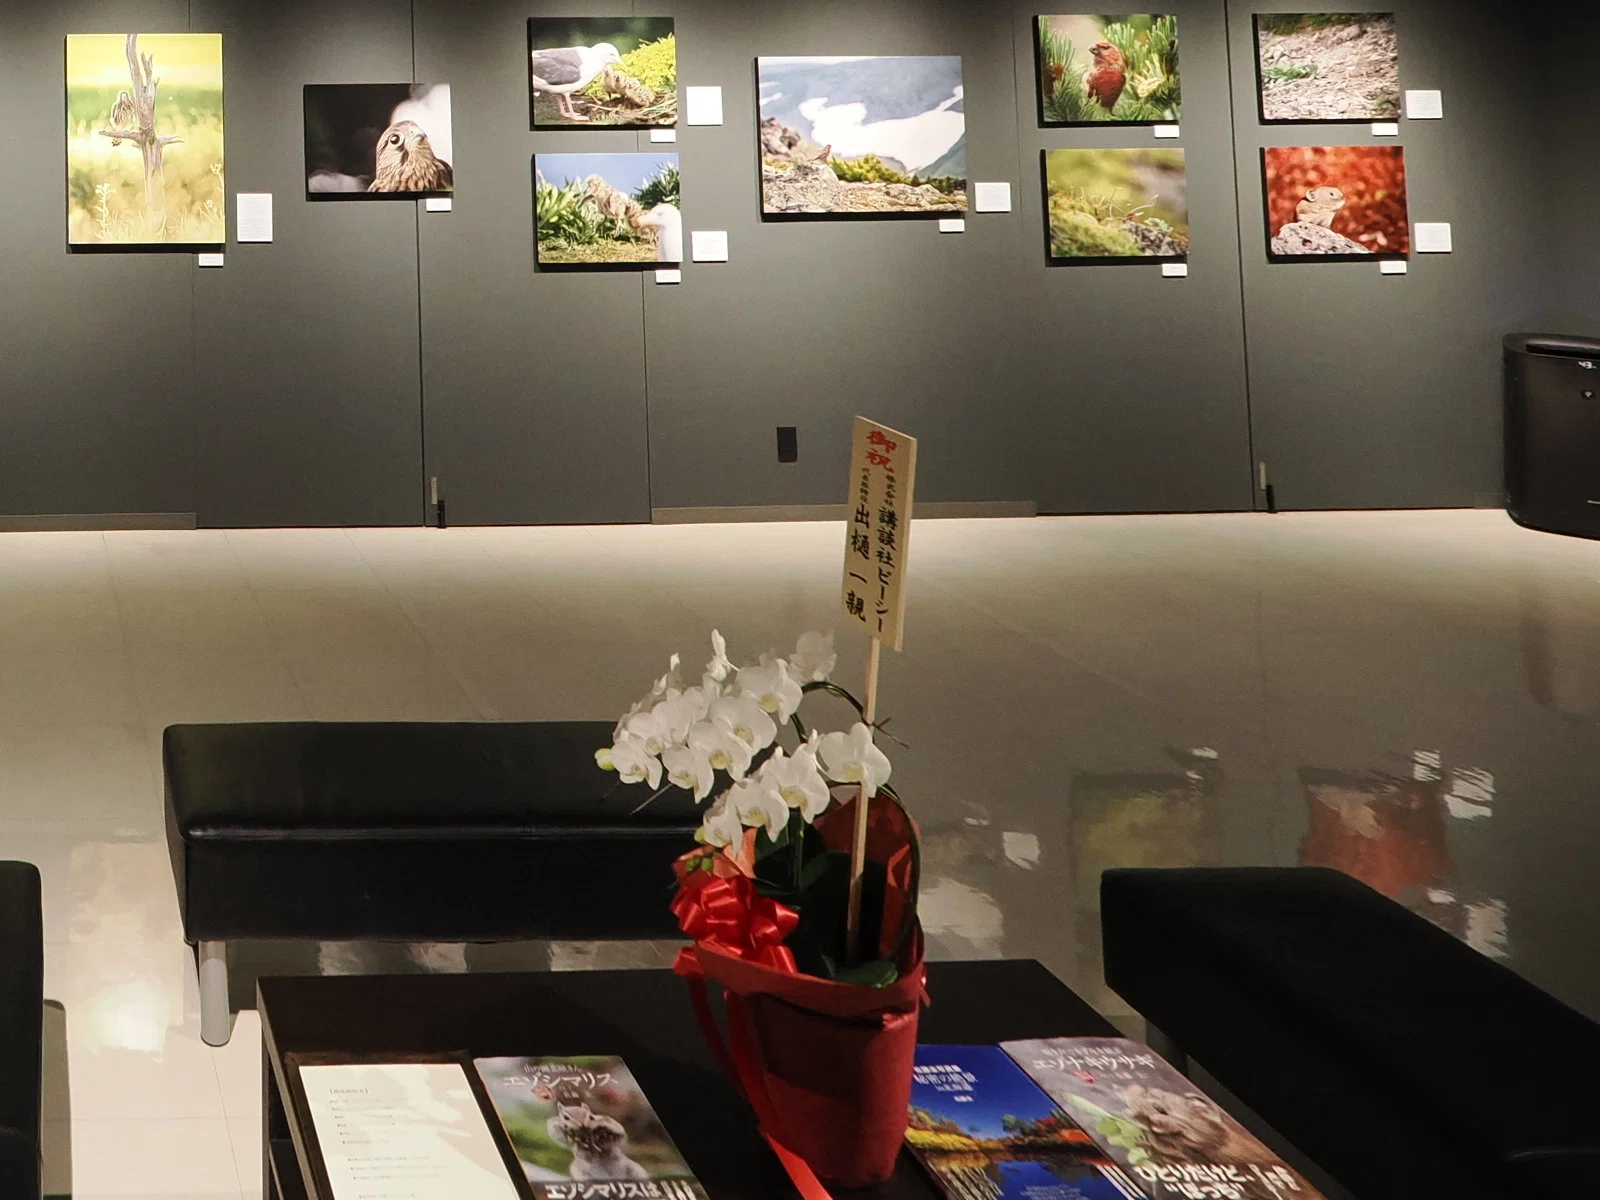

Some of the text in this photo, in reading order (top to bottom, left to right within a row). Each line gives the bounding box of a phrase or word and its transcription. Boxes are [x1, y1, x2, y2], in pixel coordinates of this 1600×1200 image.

[865, 430, 897, 473] 御祝
[502, 1072, 619, 1089] エゾシマリス
